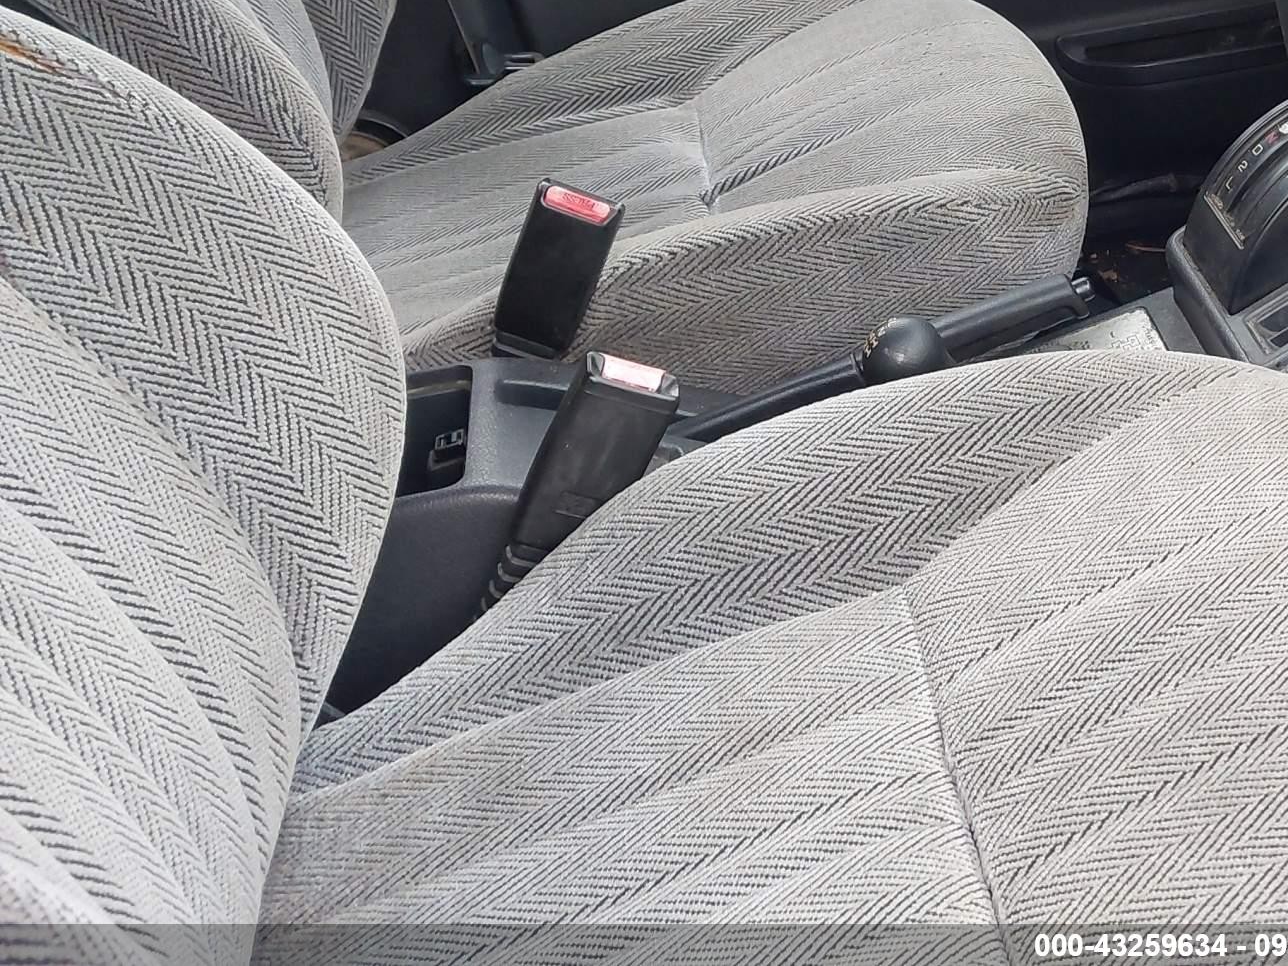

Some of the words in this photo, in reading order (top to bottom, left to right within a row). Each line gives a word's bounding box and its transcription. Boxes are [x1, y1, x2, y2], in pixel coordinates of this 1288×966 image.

[1252, 144, 1263, 155] D
[1238, 161, 1248, 172] 2
[1225, 176, 1234, 191] L
